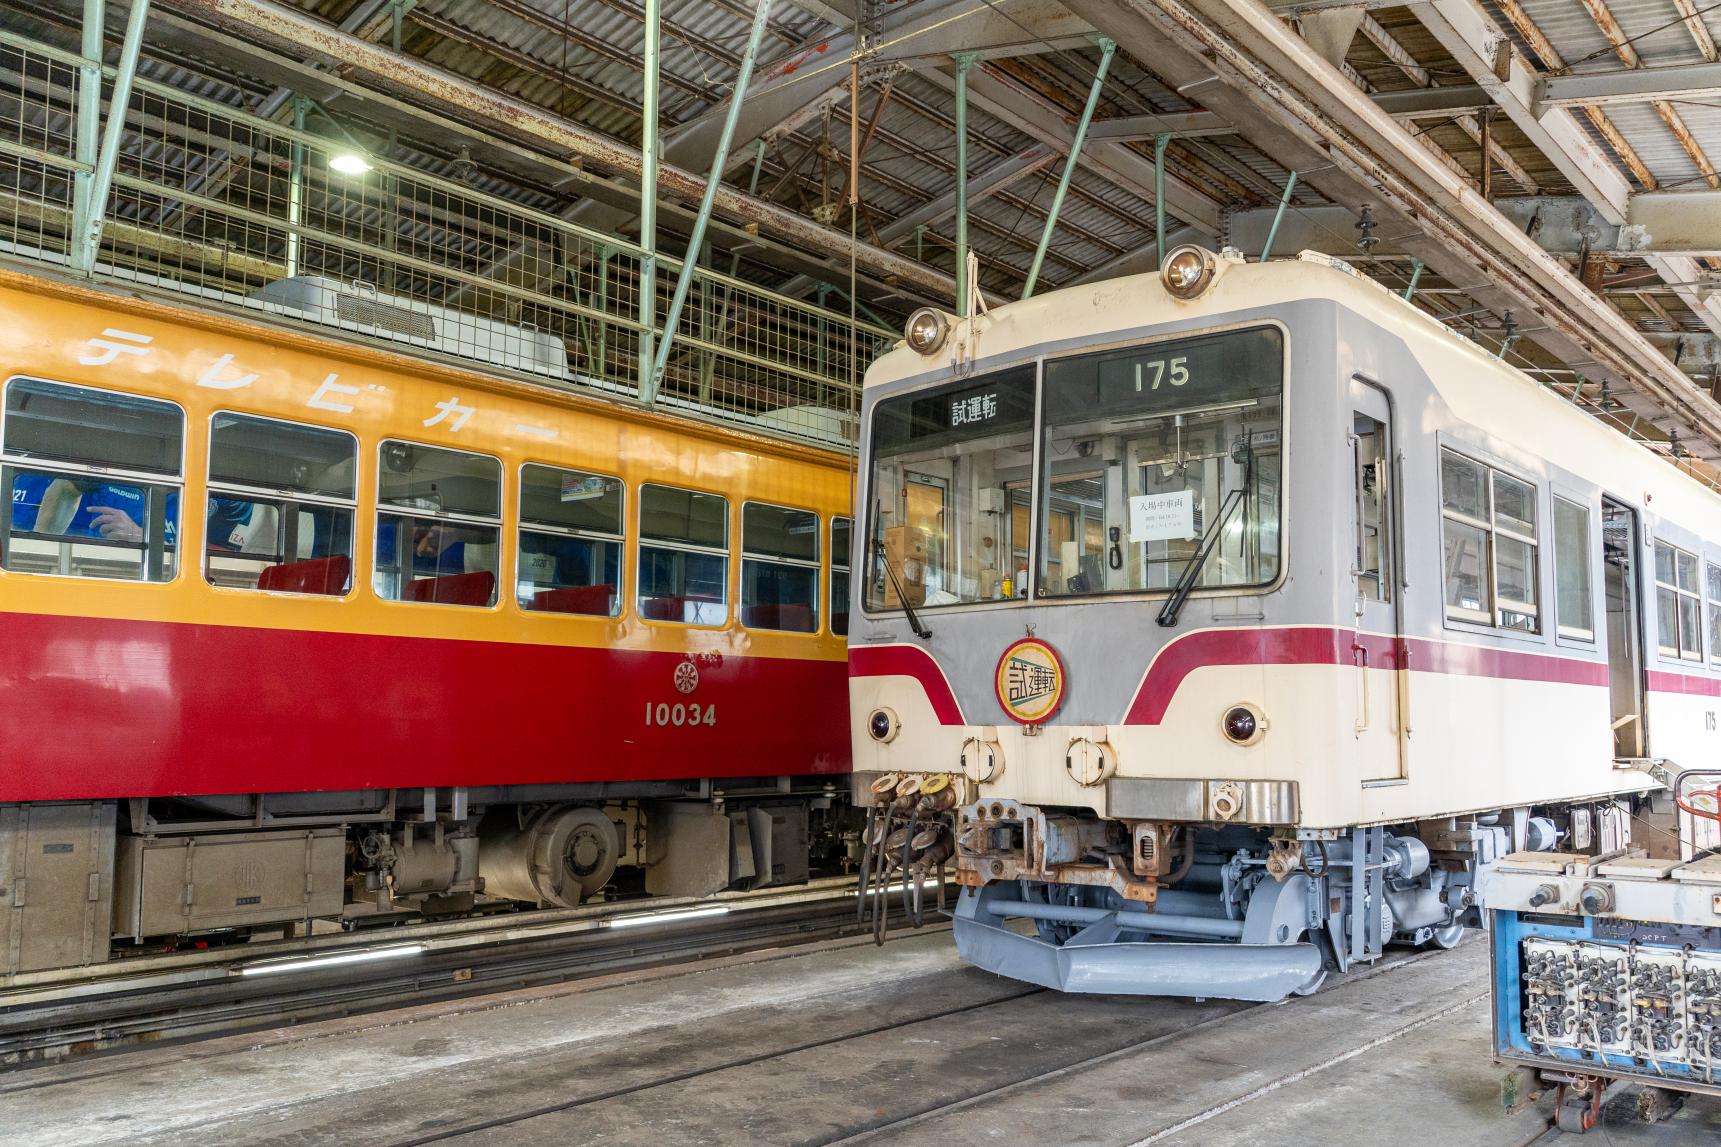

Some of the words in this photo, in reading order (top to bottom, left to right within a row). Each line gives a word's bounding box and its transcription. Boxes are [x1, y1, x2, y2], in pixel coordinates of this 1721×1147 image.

[79, 327, 559, 438] テレビカー
[1135, 357, 1189, 391] 175
[952, 393, 997, 426] 試運転
[646, 702, 716, 726] 10034
[1705, 711, 1716, 731] 175
